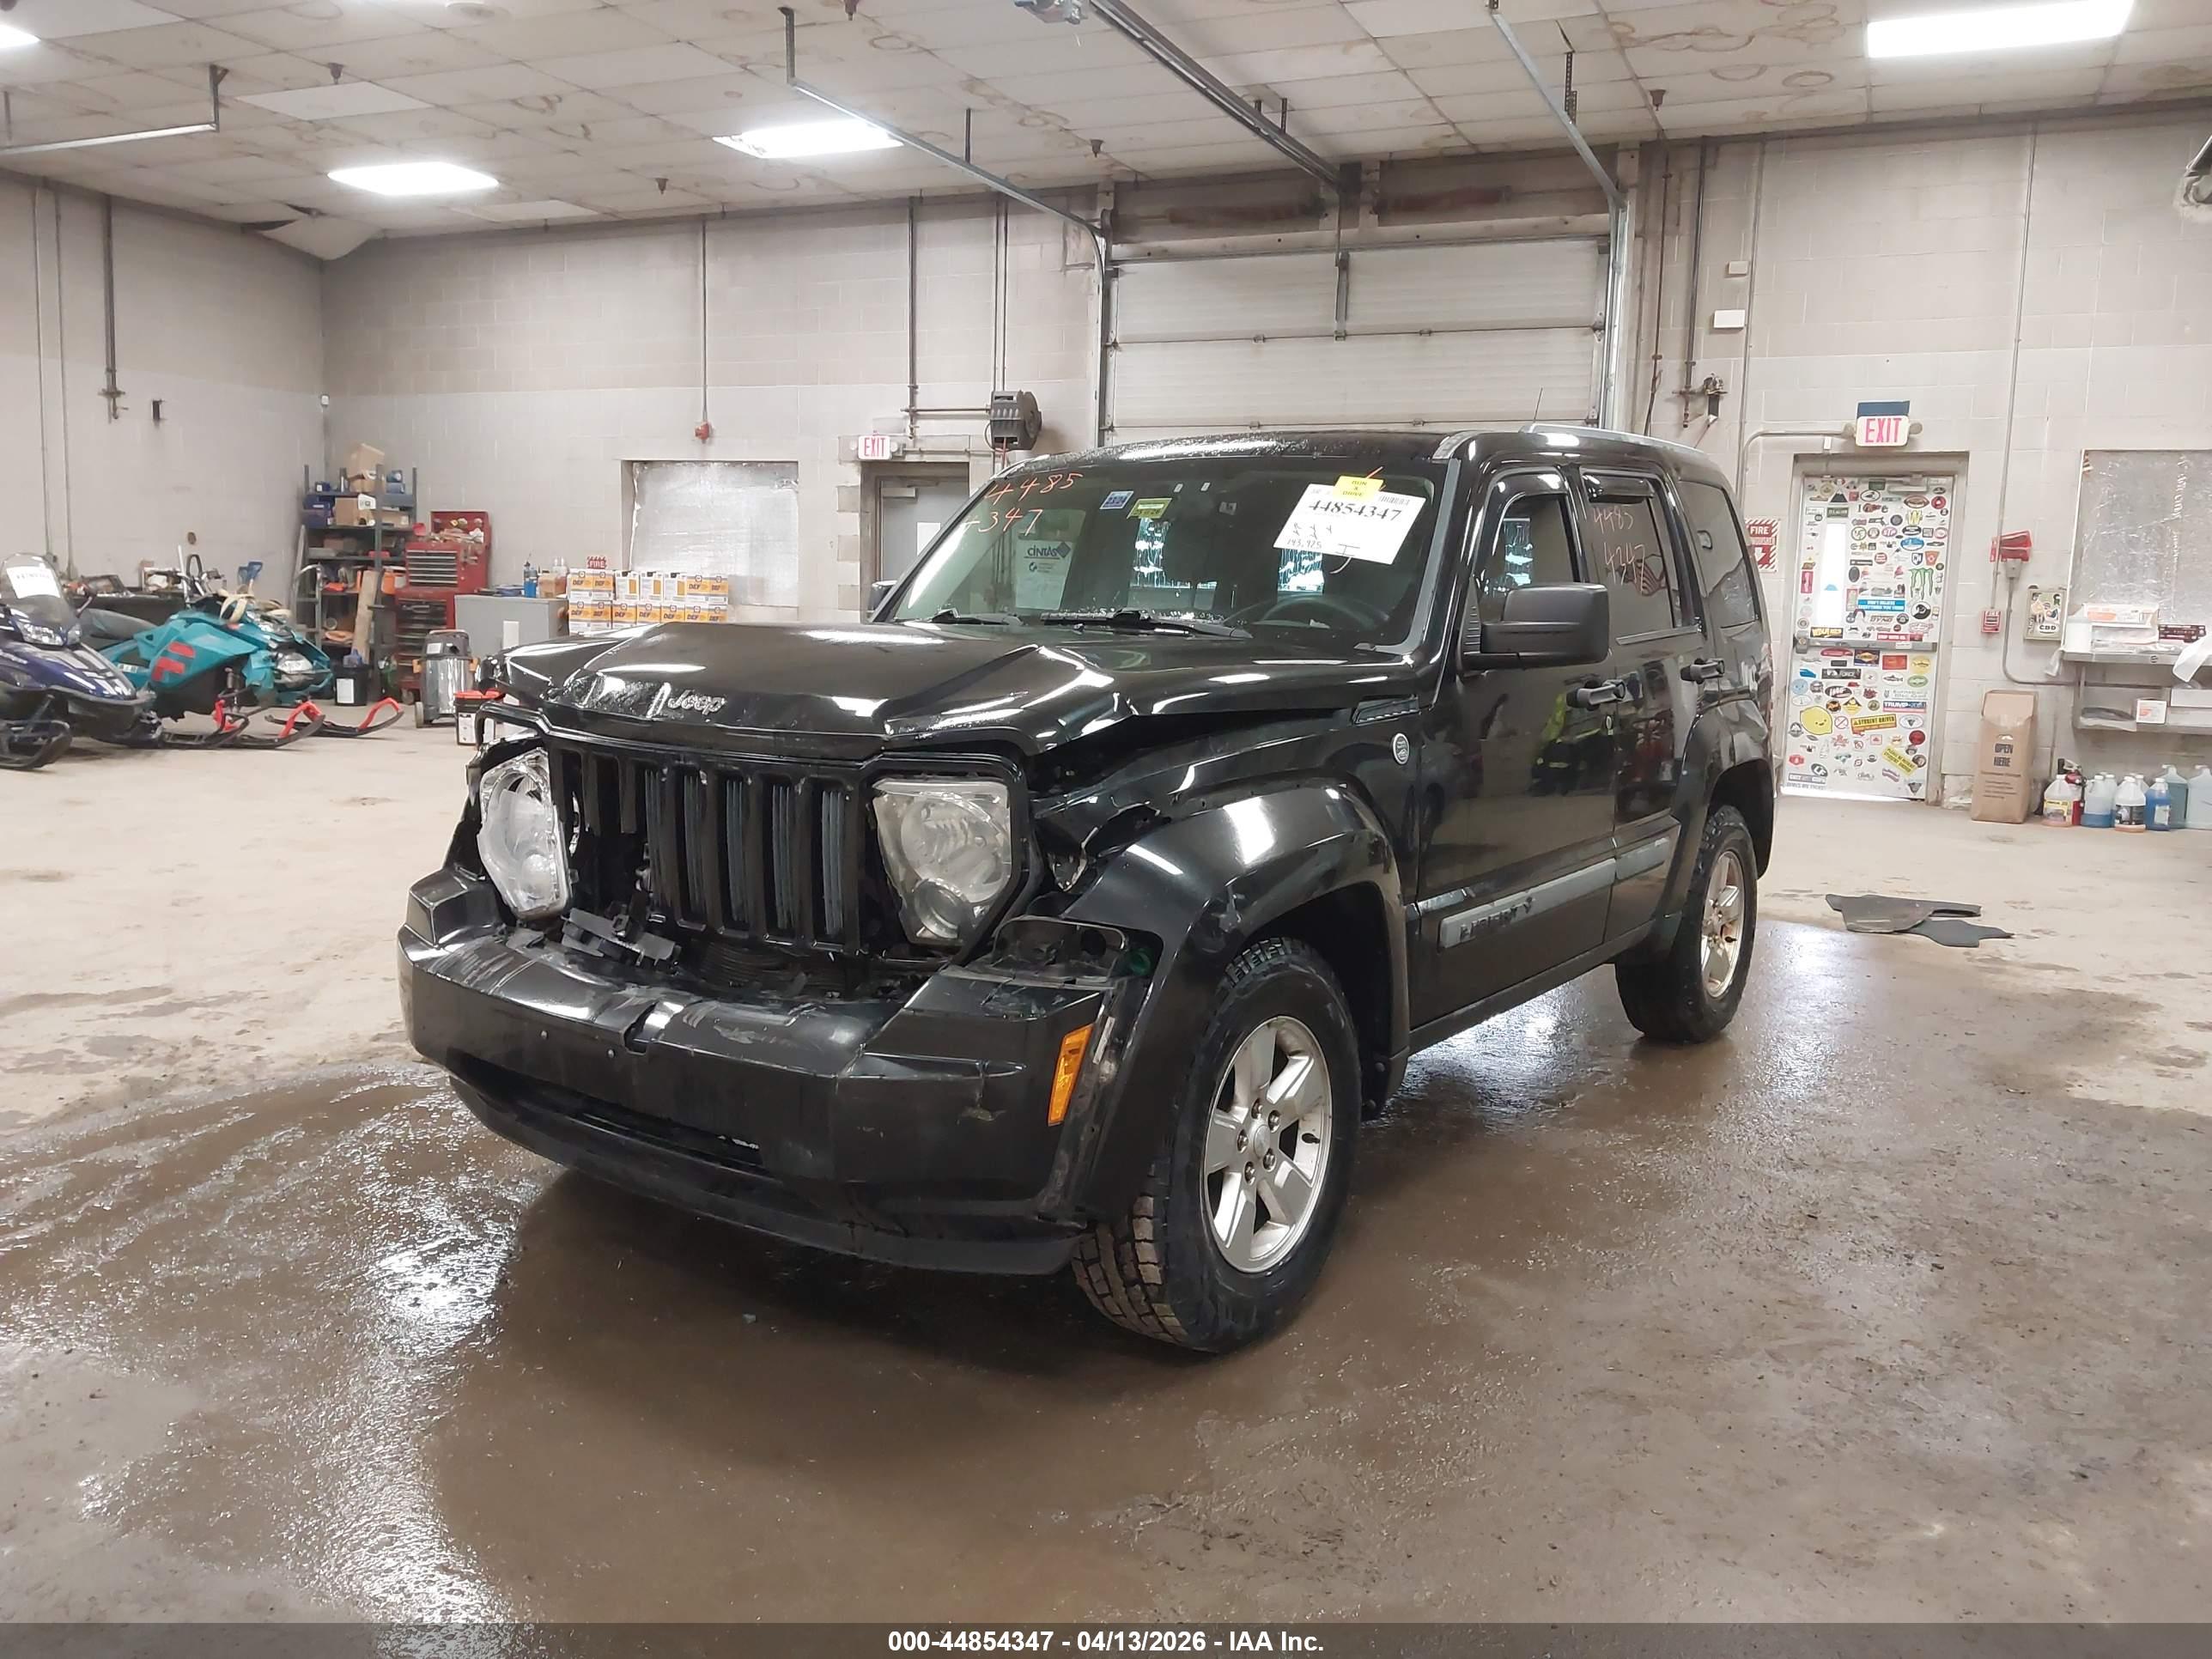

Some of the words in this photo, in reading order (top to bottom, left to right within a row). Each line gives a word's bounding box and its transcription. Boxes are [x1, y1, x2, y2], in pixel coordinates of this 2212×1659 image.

[1865, 418, 1901, 442] EXIT
[864, 437, 885, 457] EXIT
[1308, 500, 1402, 521] 44854347
[1750, 526, 1770, 535] FIRE
[667, 690, 726, 715] Jeep
[1995, 744, 2014, 754] OPEN
[1994, 757, 2011, 767] HERE
